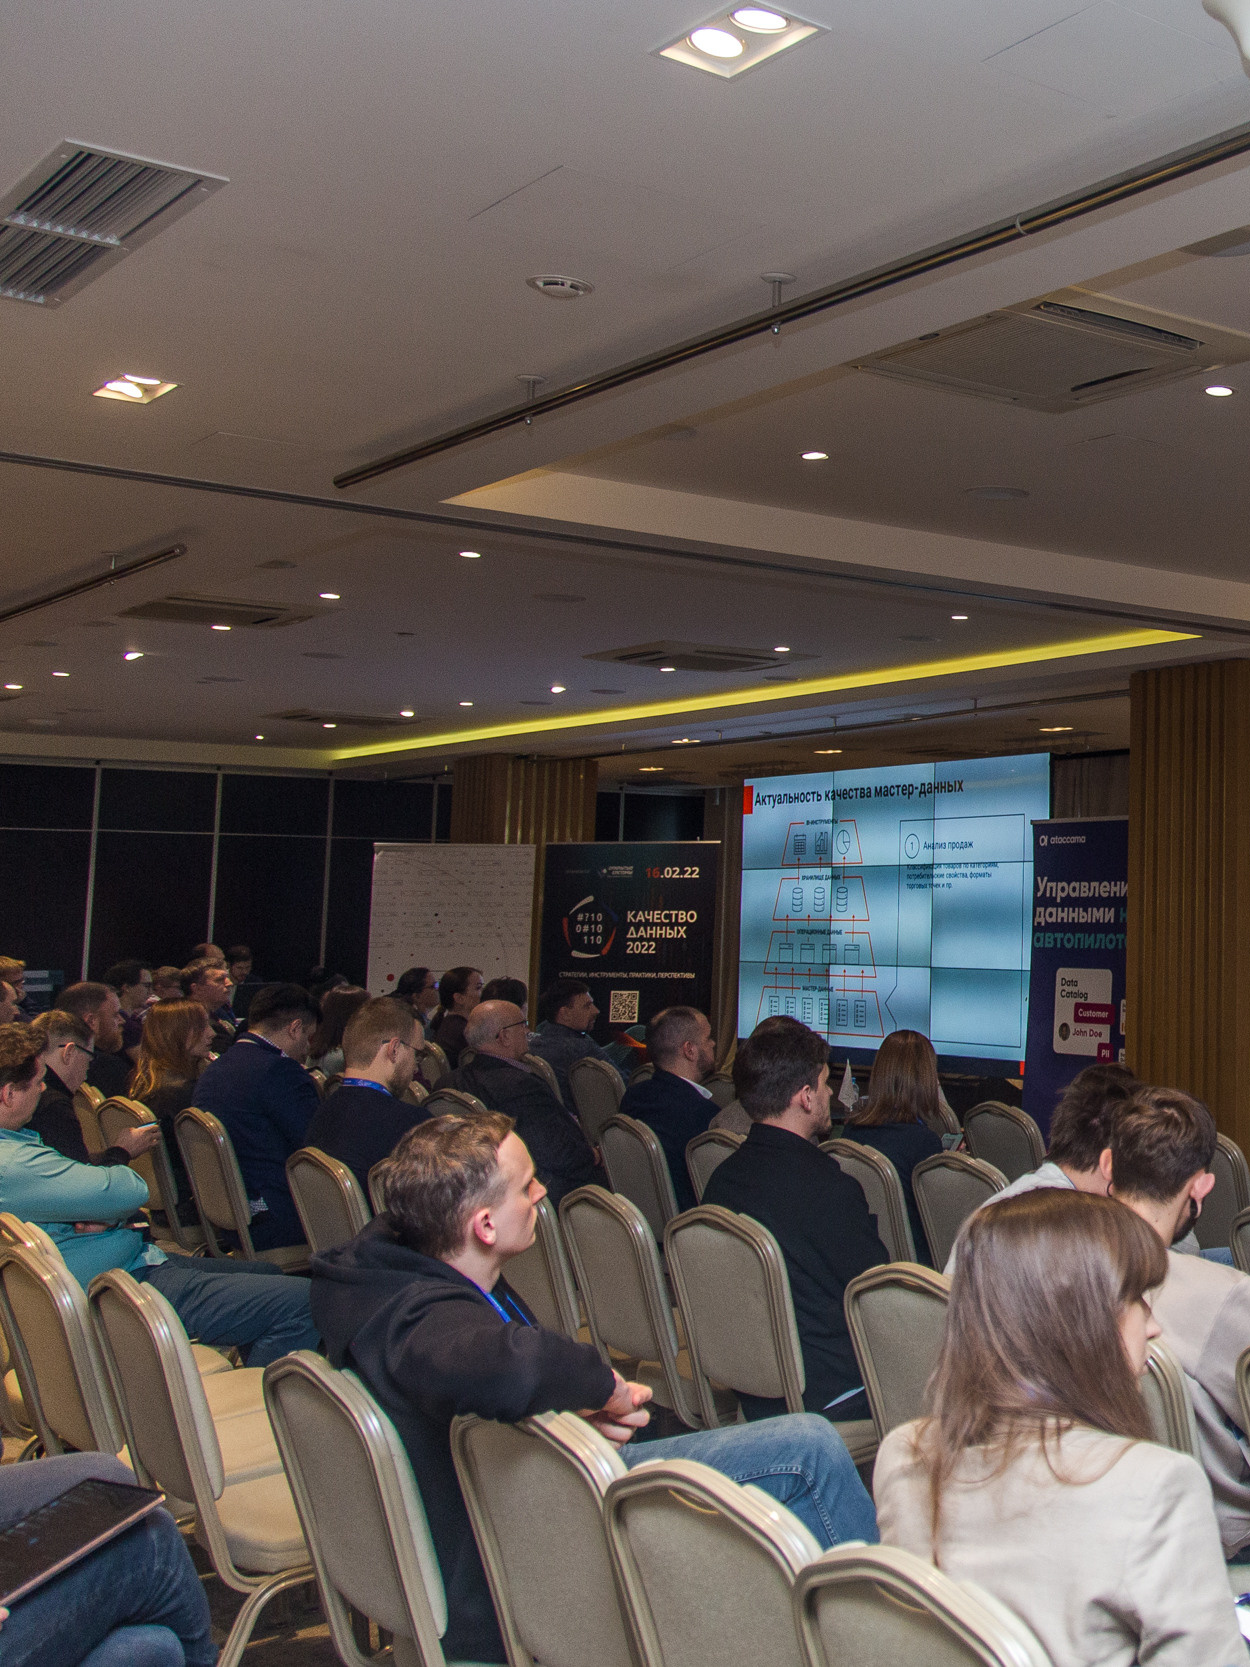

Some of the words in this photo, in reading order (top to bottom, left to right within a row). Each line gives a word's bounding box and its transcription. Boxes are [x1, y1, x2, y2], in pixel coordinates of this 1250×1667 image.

[754, 789, 822, 808] Актуальность
[824, 785, 872, 801] качества
[874, 780, 964, 800] мастер-данных
[923, 841, 946, 850] Анализ
[947, 841, 974, 851] продаж
[1050, 836, 1086, 844] ataccama
[645, 866, 700, 879] 16.02.22
[1037, 876, 1129, 903] Управлени
[576, 913, 603, 922] #?10
[626, 910, 697, 923] КАЧЕСТВО
[1034, 907, 1115, 926] данными
[575, 924, 603, 933] 0#10
[626, 926, 687, 939] ДАННЫХ
[583, 935, 603, 945] 110
[1033, 932, 1127, 949] автопилот
[626, 941, 656, 954] 2022
[1060, 977, 1078, 987] Data
[1060, 989, 1089, 1001] Catalog
[1078, 1008, 1109, 1018] Customer
[1072, 1028, 1088, 1038] John
[1089, 1028, 1103, 1038] Doe
